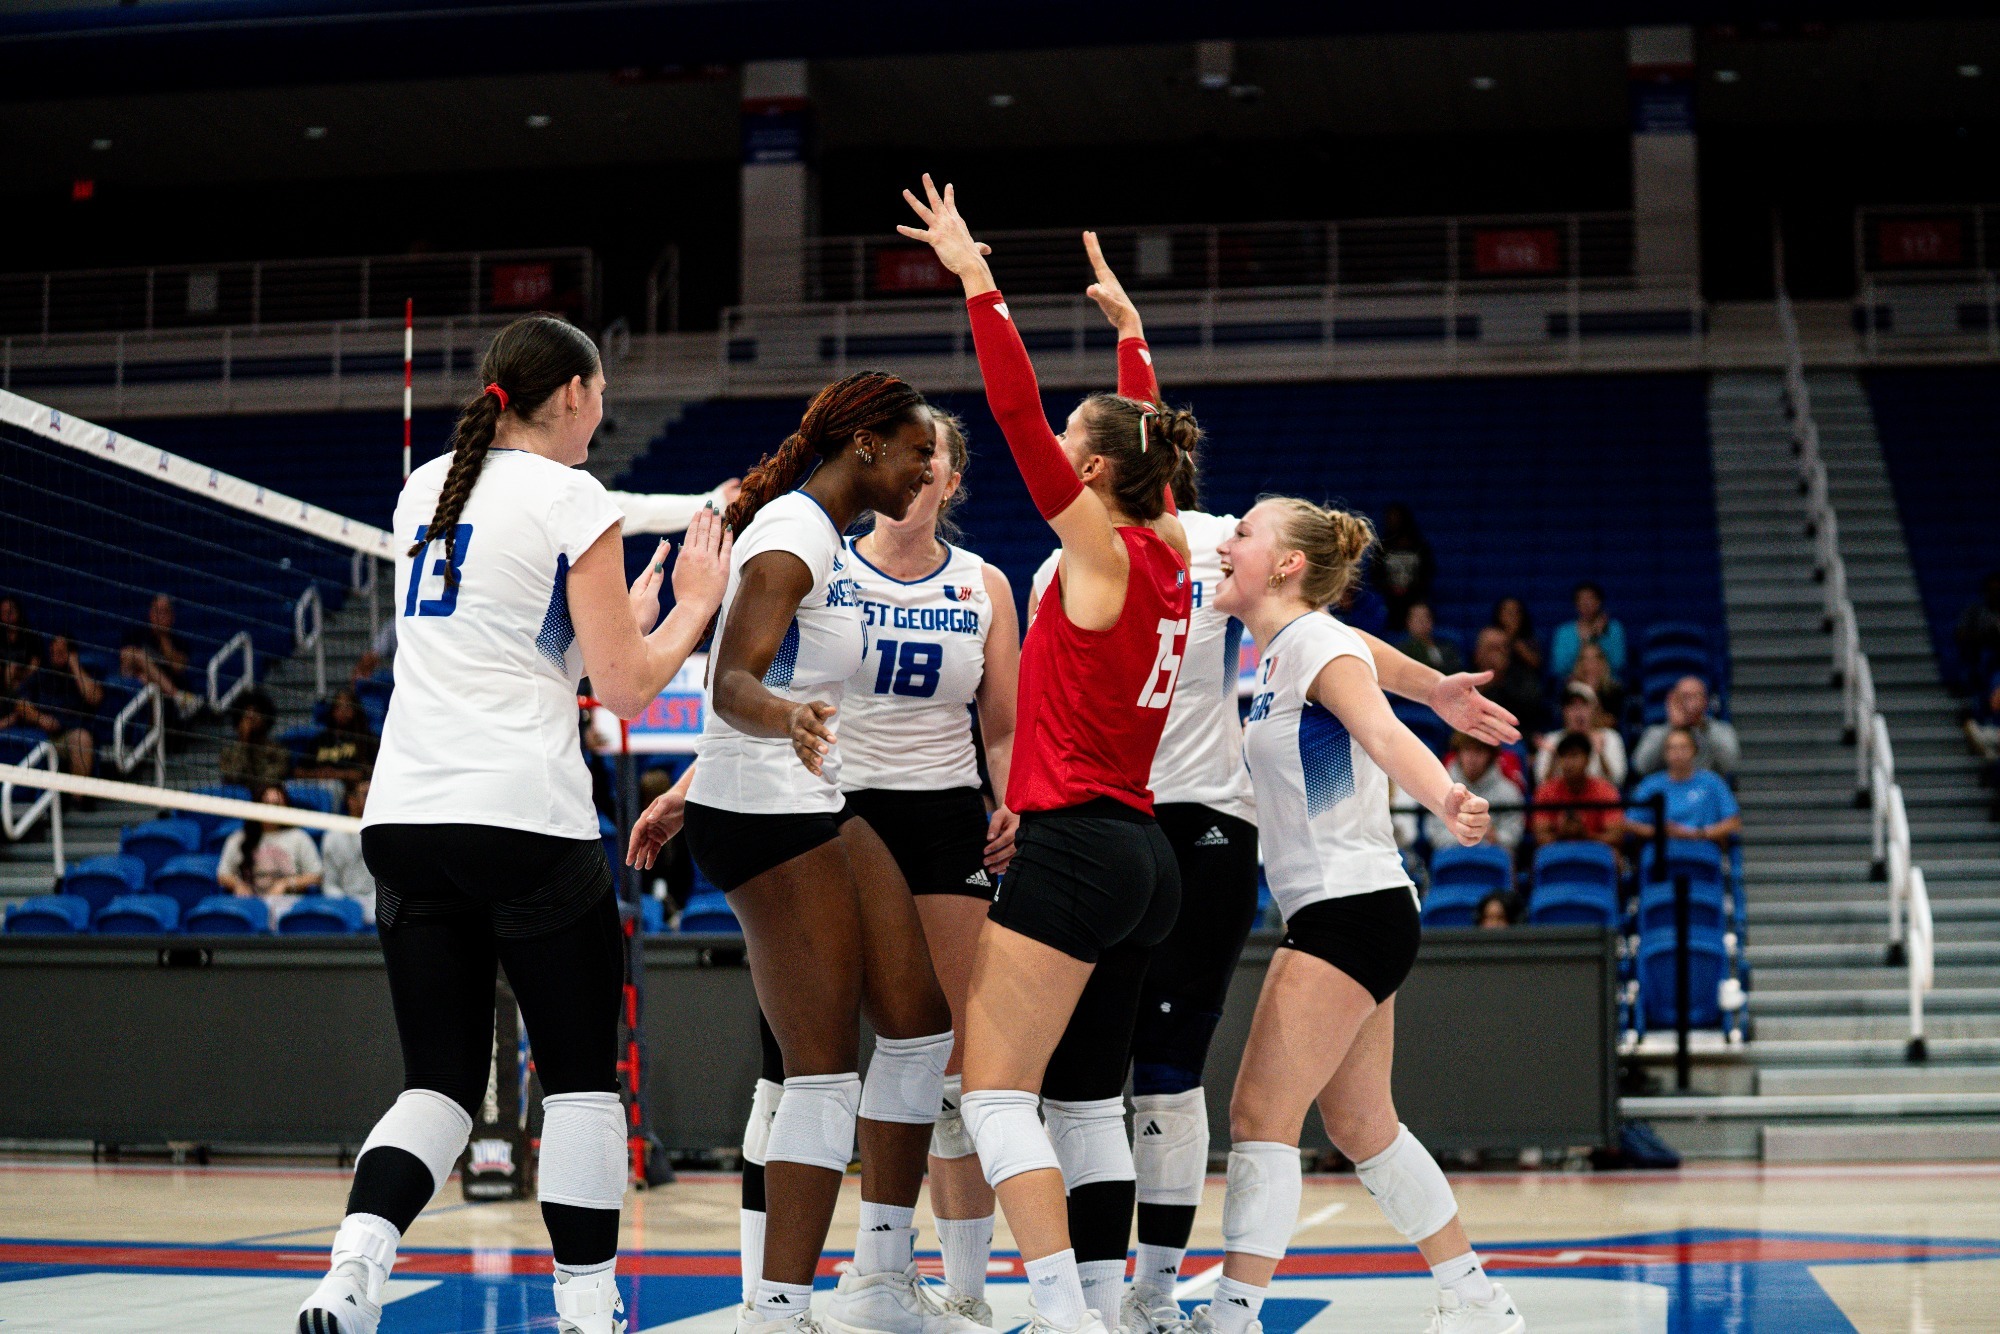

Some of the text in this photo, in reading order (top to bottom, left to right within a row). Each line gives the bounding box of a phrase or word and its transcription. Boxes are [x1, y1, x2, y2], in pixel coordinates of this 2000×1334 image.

[404, 524, 473, 617] 13
[859, 601, 979, 636] ST GEORGIA
[874, 639, 943, 698] 18
[1137, 618, 1187, 709] 15
[1194, 837, 1229, 847] adidas
[965, 878, 991, 888] adidas
